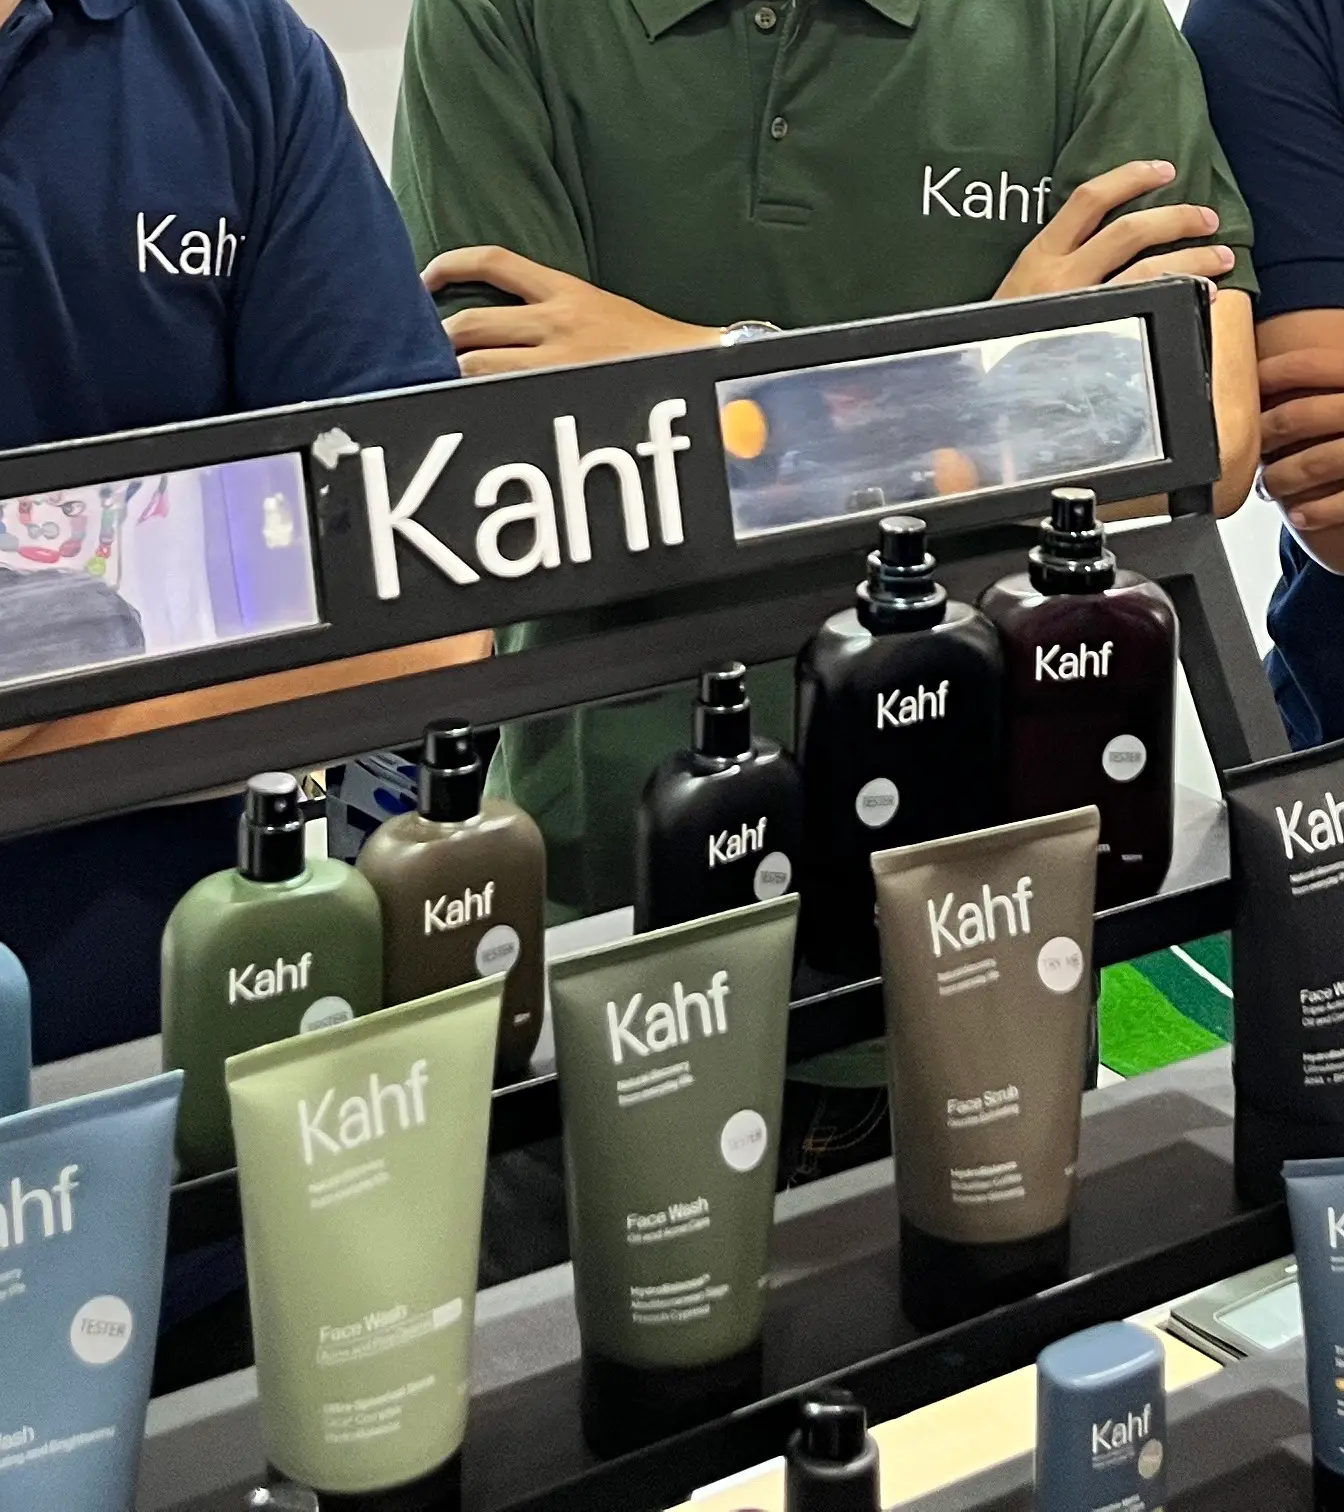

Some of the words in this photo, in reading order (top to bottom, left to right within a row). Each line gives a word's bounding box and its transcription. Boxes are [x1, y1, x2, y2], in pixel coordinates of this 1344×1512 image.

[923, 165, 1053, 225] Kahf
[137, 211, 246, 277] Kah
[360, 398, 692, 601] Kahf
[1036, 641, 1113, 681] Kahf
[877, 680, 949, 730] Kahf
[709, 816, 768, 869] Kahf
[424, 881, 496, 935] Kahf
[927, 876, 1033, 957] Kahf
[227, 951, 313, 1004] Kahf
[1300, 988, 1332, 1003] Face
[607, 970, 731, 1065] Kahf
[298, 1058, 429, 1165] Kahf
[627, 1210, 667, 1230] Face
[668, 1196, 709, 1223] Wash
[80, 1317, 126, 1338] TESTER
[320, 1321, 361, 1344] Face
[362, 1303, 408, 1330] Wash
[1092, 1403, 1151, 1454] Kahf
